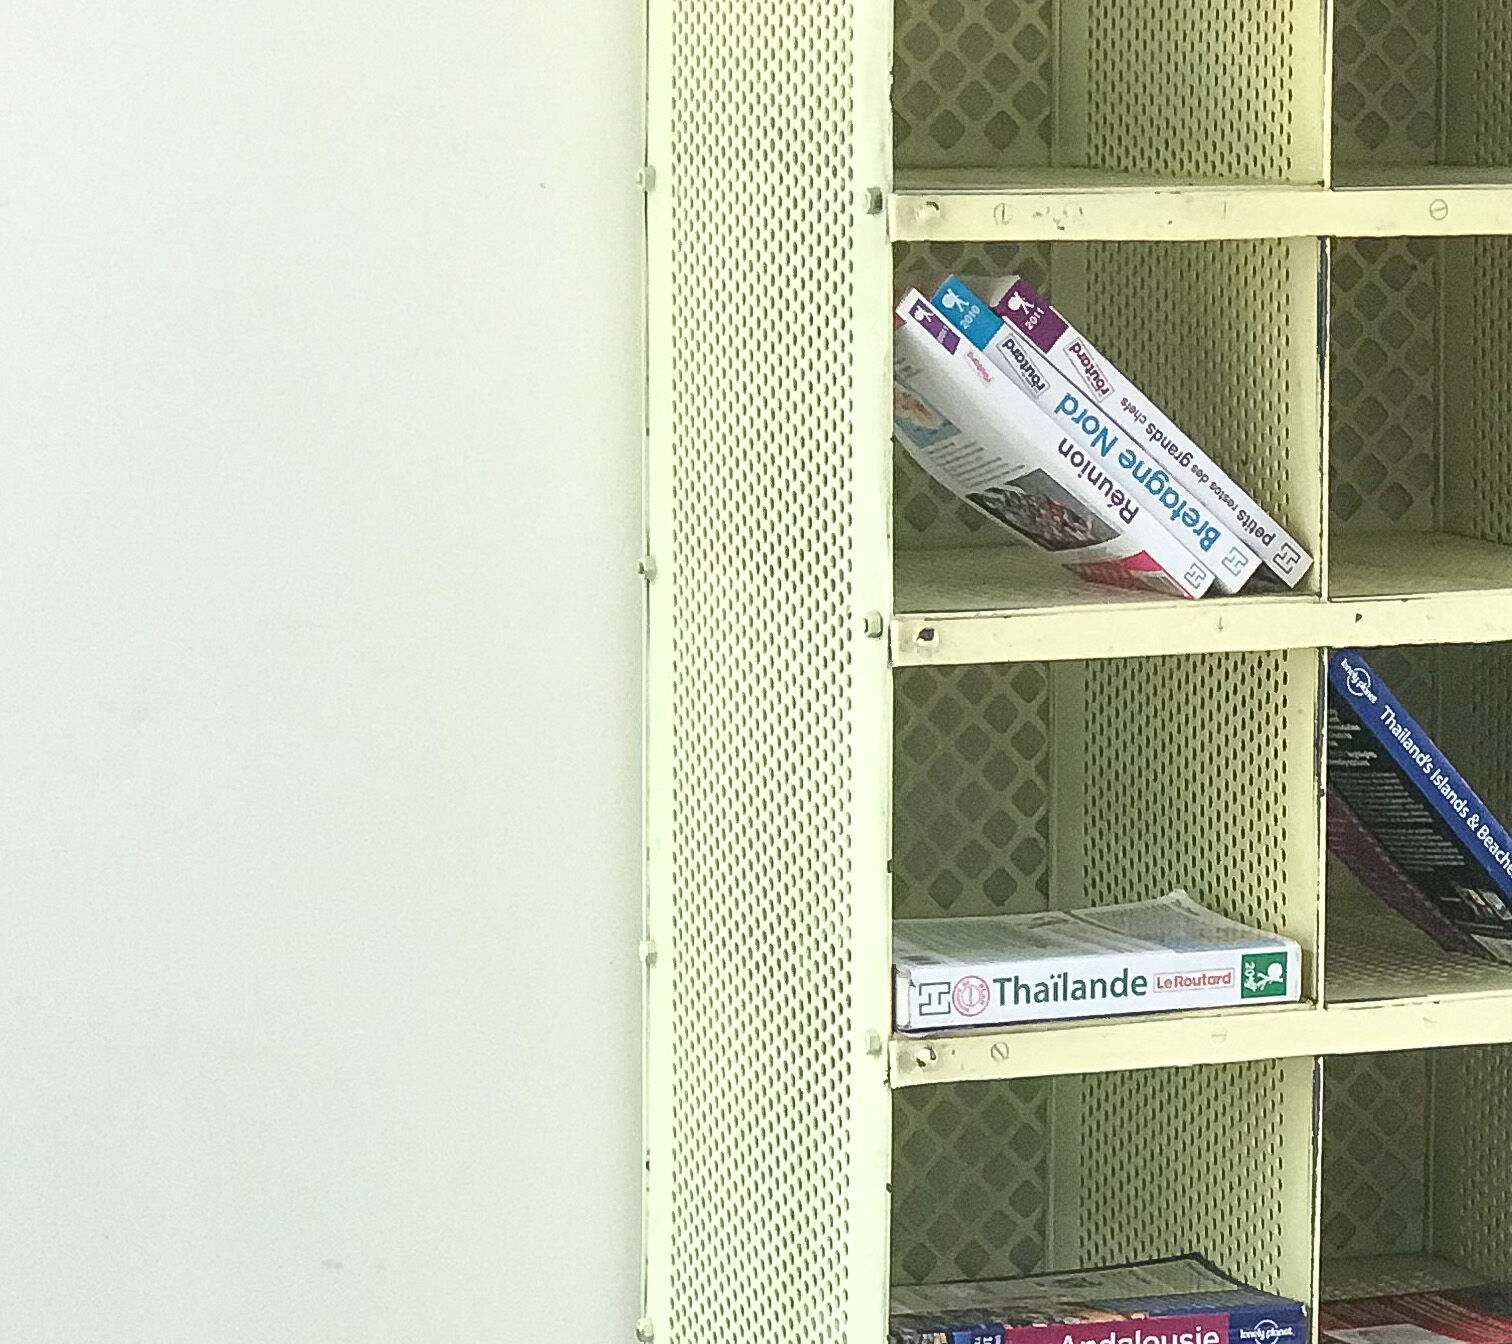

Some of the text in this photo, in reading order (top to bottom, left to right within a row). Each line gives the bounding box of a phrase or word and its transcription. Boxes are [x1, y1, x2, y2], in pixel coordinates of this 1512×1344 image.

[960, 304, 981, 330] 2010
[1024, 307, 1045, 331] 2011
[1002, 336, 1047, 392] routard
[1051, 437, 1141, 523] Réunion
[1053, 393, 1224, 551] Bretagne Nord
[1118, 397, 1275, 547] petits restos des grands chefs
[1340, 658, 1378, 704] lonely planet
[1380, 705, 1433, 774] Thailand's
[1429, 768, 1470, 817] Islands
[1466, 812, 1480, 830] &
[993, 968, 1149, 1006] Thaïlande
[1240, 1327, 1294, 1341] lonely planet
